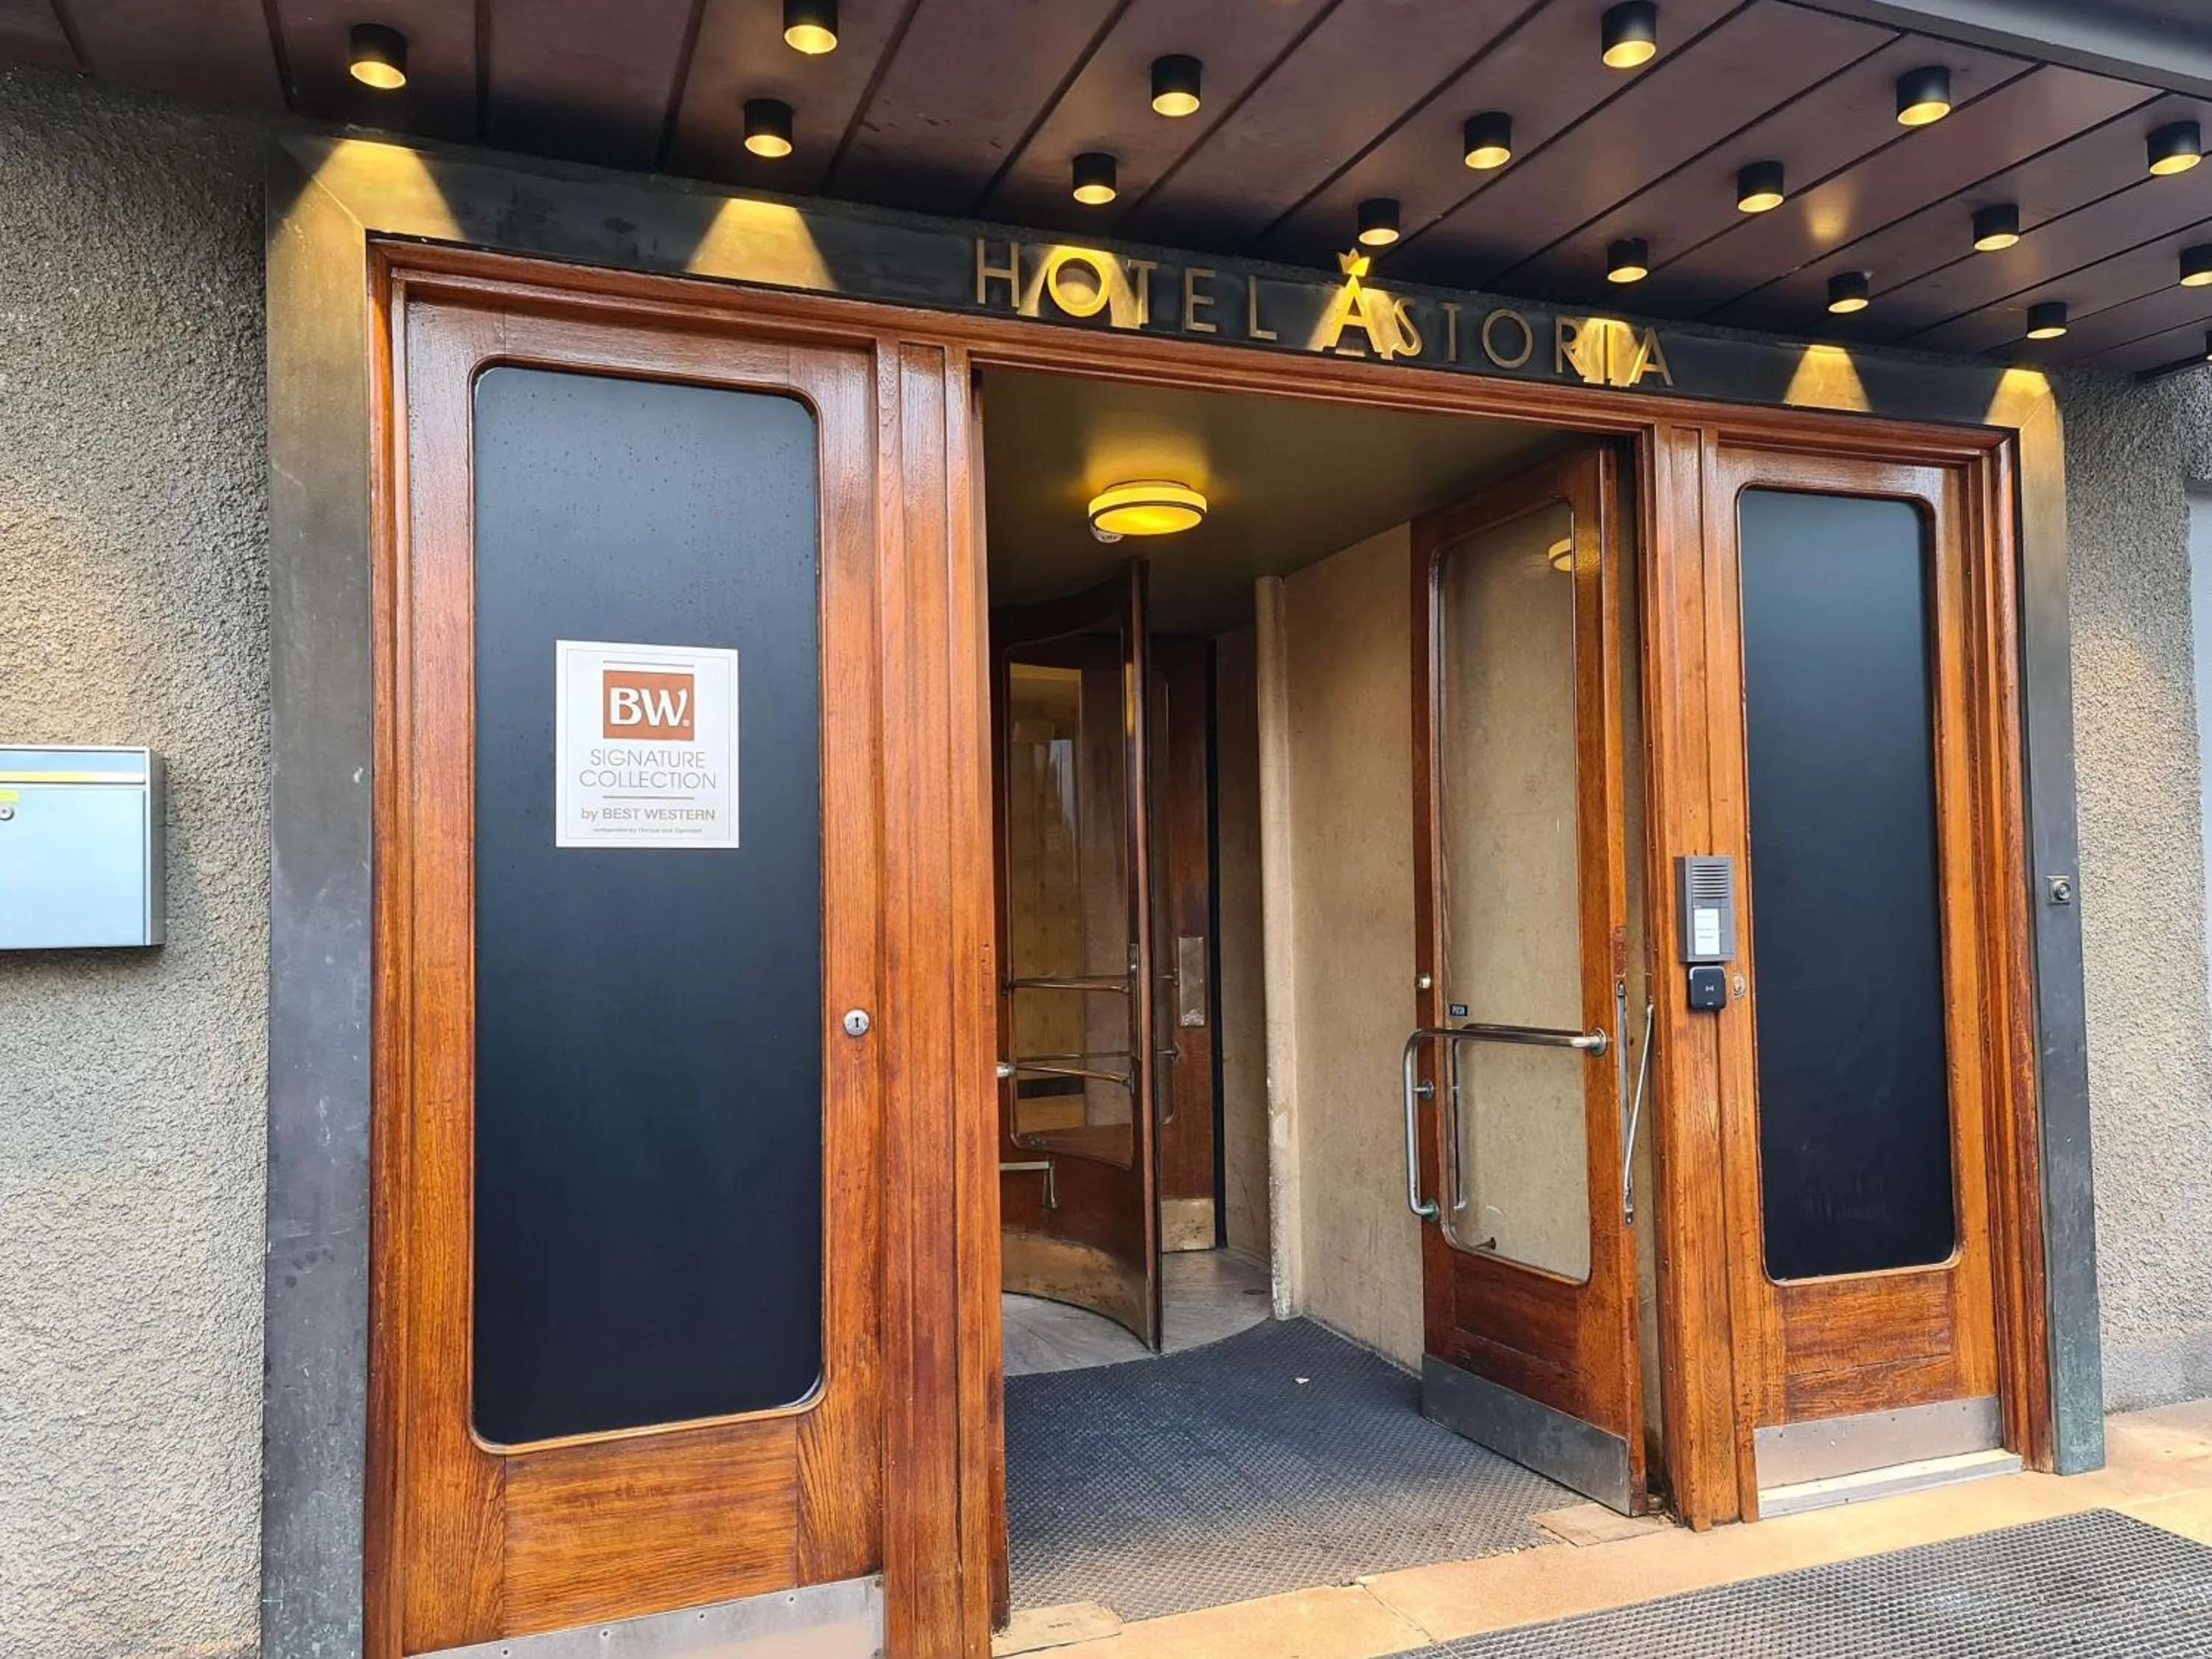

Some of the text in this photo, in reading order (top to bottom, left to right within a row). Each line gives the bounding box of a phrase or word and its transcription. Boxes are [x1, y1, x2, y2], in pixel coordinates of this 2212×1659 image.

[976, 237, 1674, 387] HOTEL ASTORIA
[590, 748, 706, 769] SIGNATURE
[579, 769, 717, 790] COLLECTION
[581, 807, 715, 822] by BEST WESTERN
